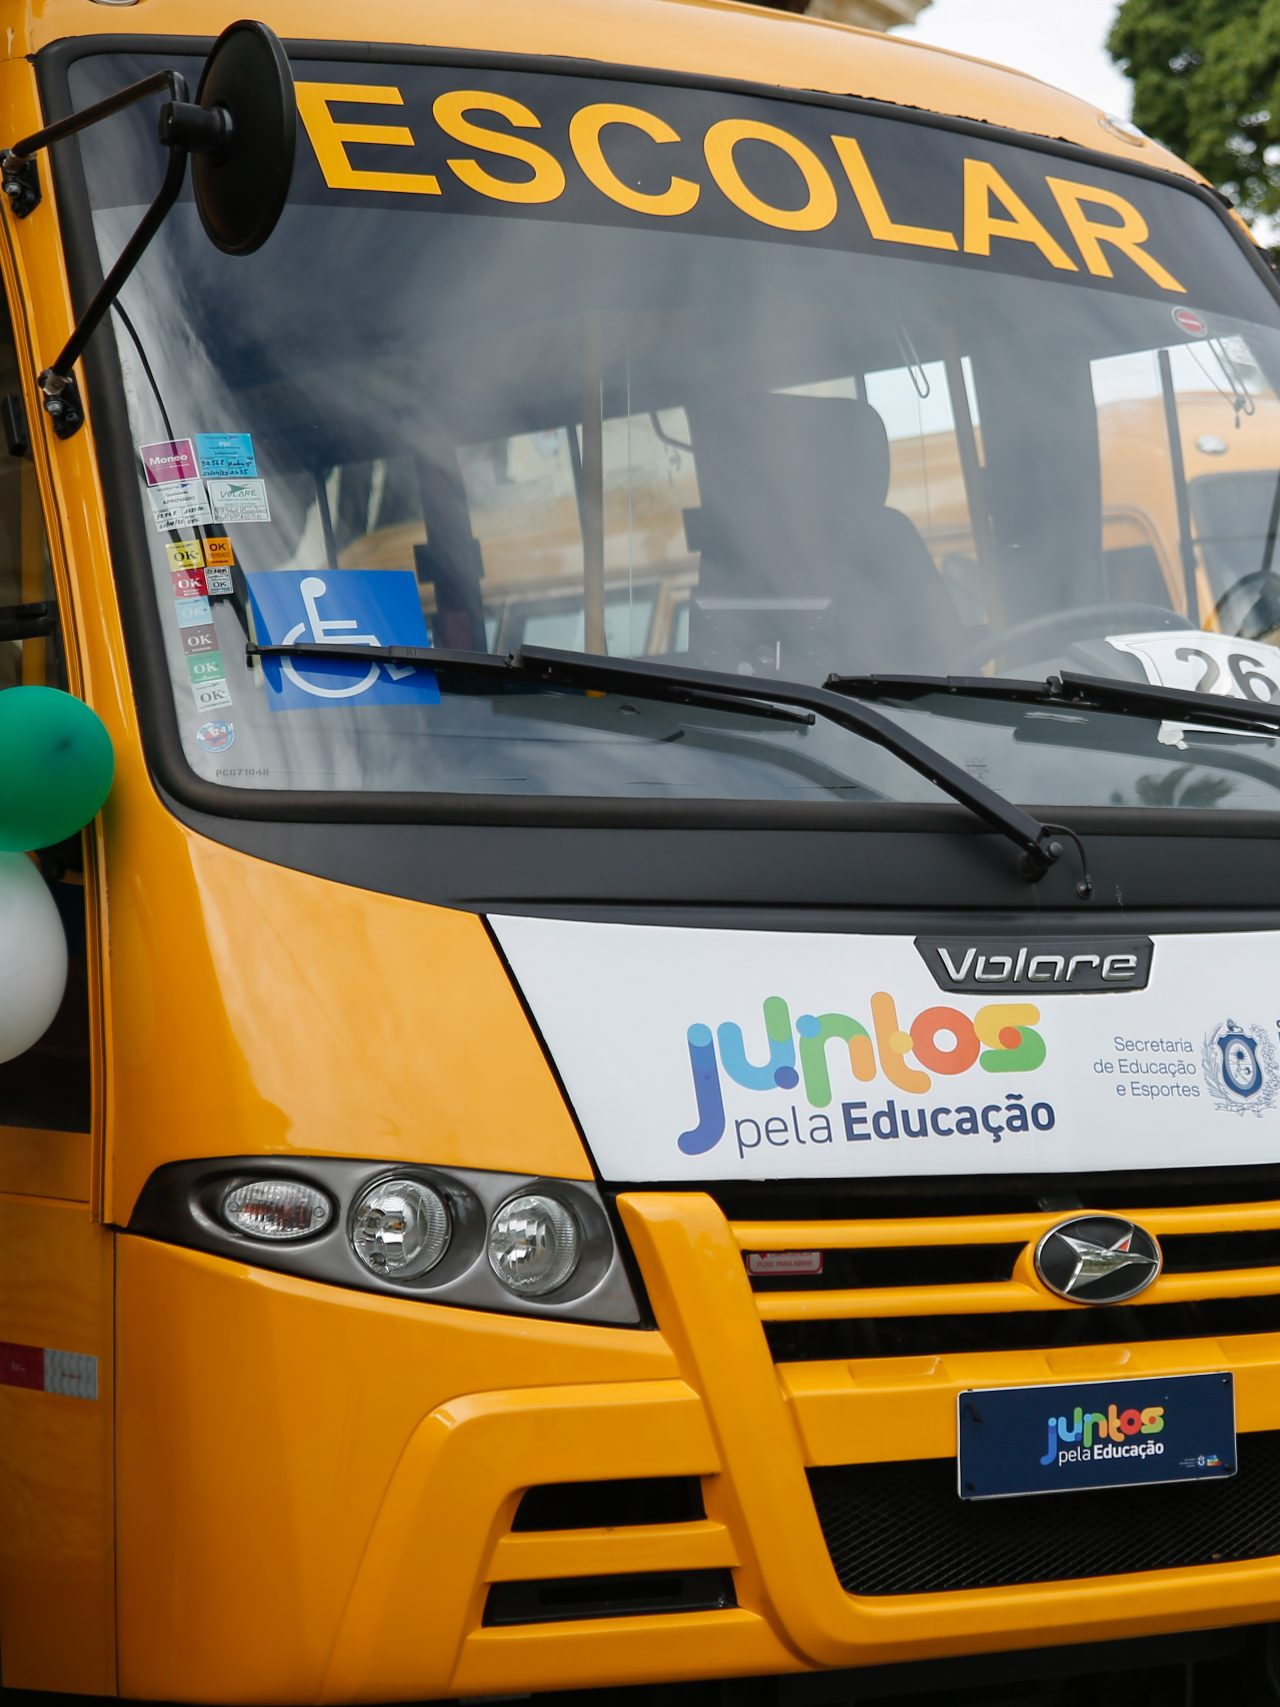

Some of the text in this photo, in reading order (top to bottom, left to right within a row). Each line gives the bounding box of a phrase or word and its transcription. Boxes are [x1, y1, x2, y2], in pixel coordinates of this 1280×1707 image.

[297, 81, 1187, 294] ESCOLAR
[149, 454, 188, 466] Moneo
[174, 551, 196, 561] OK
[210, 543, 226, 552] OK
[178, 578, 203, 589] OK
[187, 634, 212, 647] OK
[193, 661, 218, 674] OK
[200, 690, 225, 703] OK
[937, 947, 1138, 983] Volare
[1113, 1036, 1194, 1053] Secretaria
[678, 991, 1047, 1155] juntos
[1093, 1058, 1197, 1078] de Educação
[1116, 1081, 1200, 1100] e Esportes
[734, 1092, 1056, 1159] pela Educação
[1040, 1404, 1165, 1465] juntos
[1059, 1440, 1165, 1467] pela Educação
